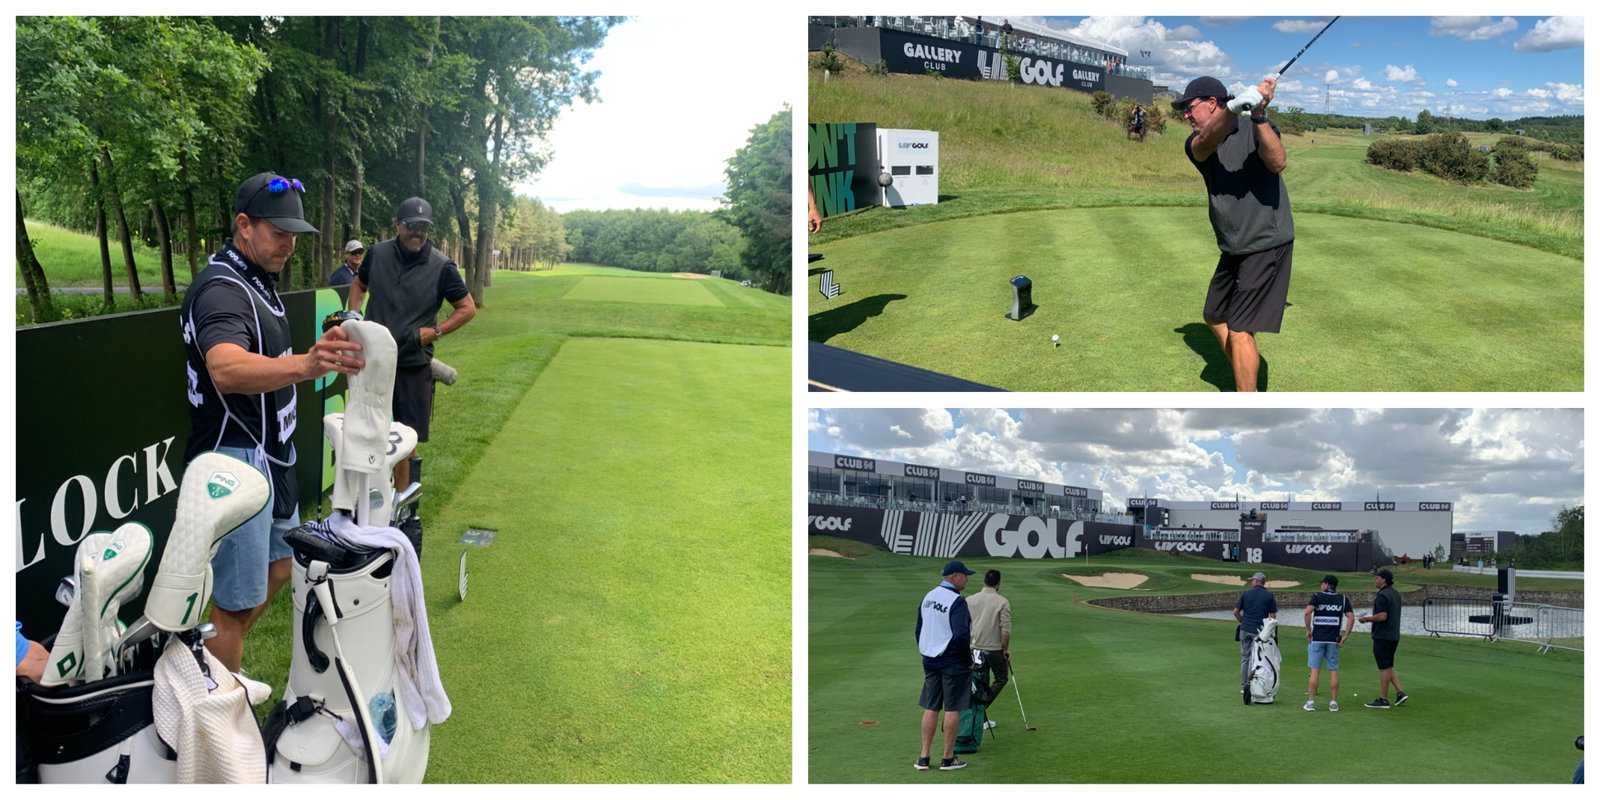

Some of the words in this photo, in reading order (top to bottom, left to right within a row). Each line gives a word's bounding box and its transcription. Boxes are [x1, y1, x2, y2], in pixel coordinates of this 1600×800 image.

[903, 42, 962, 63] GALLERY
[924, 61, 946, 71] CLUB
[977, 50, 1021, 81] LI
[1020, 57, 1064, 87] GOLF
[1072, 69, 1100, 82] GALLERY
[836, 457, 863, 469] CLUB
[906, 466, 929, 477] CLUB
[966, 474, 986, 484] CLUB
[1019, 481, 1037, 491] CLUB
[815, 515, 852, 531] GOLF
[881, 509, 988, 558] LIV
[984, 513, 1084, 558] GOLF
[1113, 535, 1131, 545] GOLF
[1176, 542, 1205, 552] GOLF
[1305, 544, 1332, 554] GOLF
[1246, 547, 1263, 564] 18
[181, 592, 199, 625] 1
